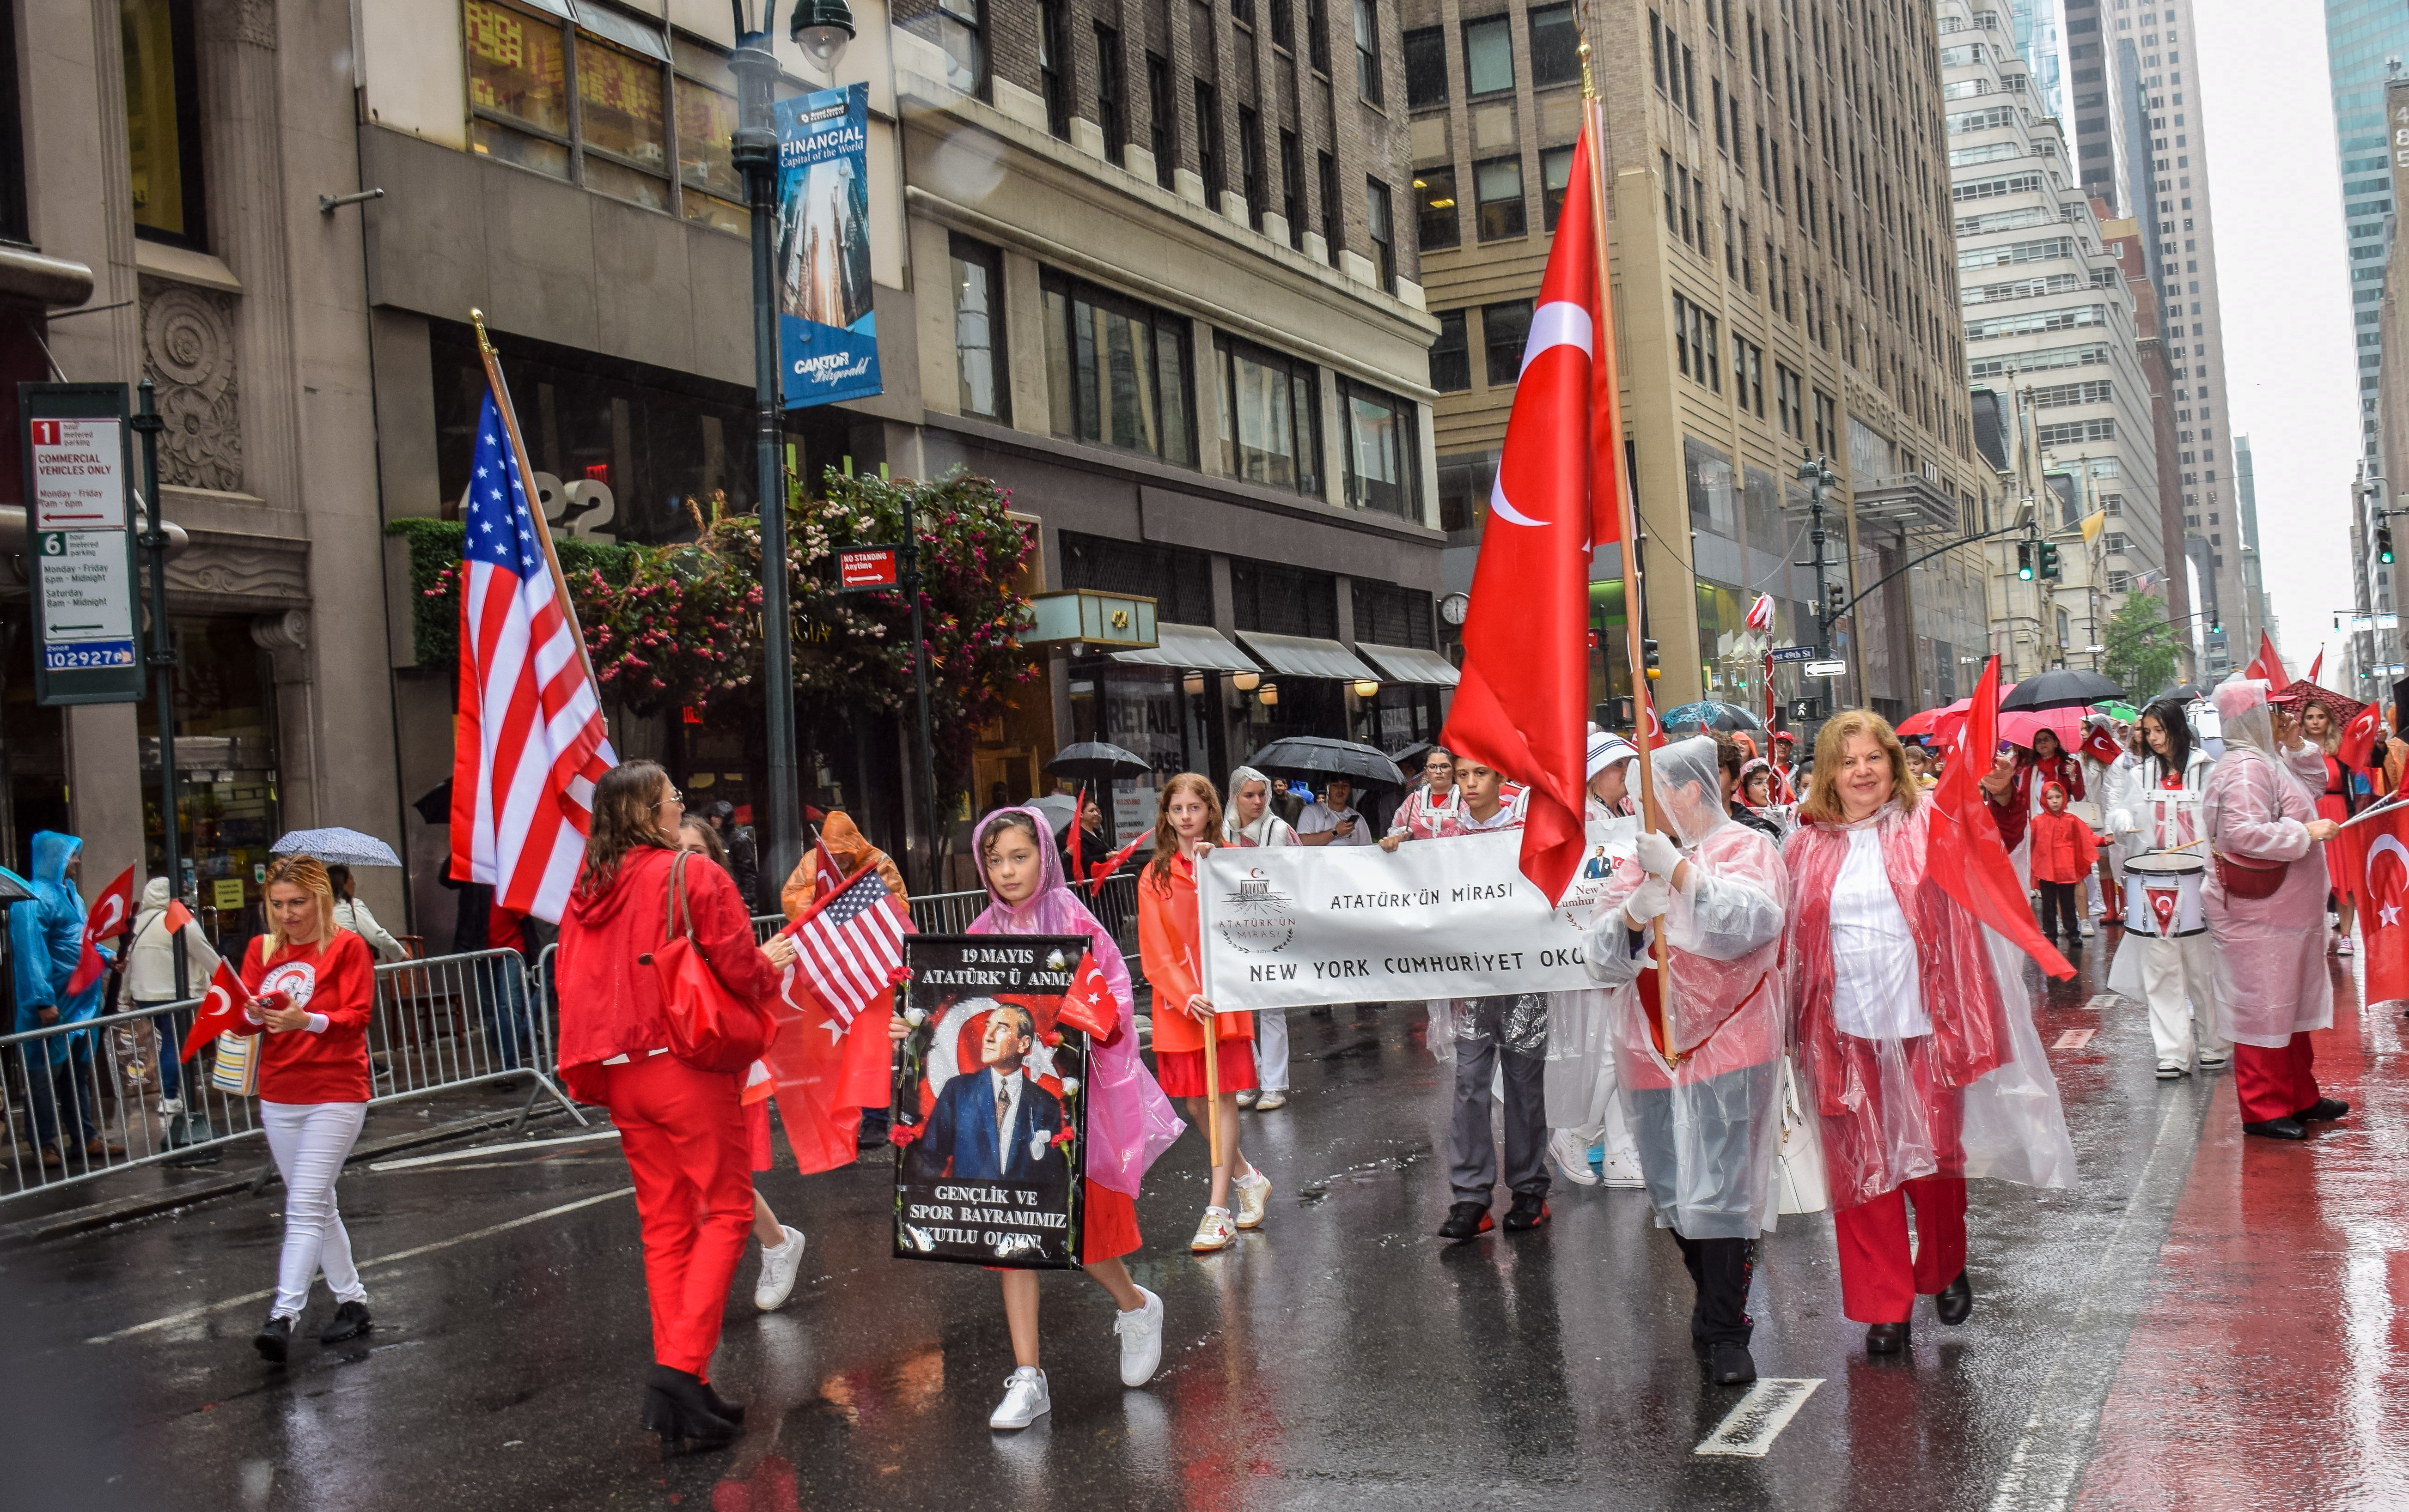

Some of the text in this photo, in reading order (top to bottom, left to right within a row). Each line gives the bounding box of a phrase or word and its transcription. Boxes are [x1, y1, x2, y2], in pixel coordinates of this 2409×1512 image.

[781, 126, 863, 157] FINANCIAL
[781, 140, 863, 168] Capital of the World
[794, 352, 849, 374] CANTOR
[41, 422, 51, 444] 1
[38, 454, 101, 464] COMMERCIAL
[39, 465, 112, 475] VEHICLES ONLY
[40, 489, 71, 499] Monday
[79, 488, 103, 499] Friday
[40, 499, 57, 508] 7am
[65, 499, 83, 509] 6pm
[46, 533, 61, 554] 6
[854, 552, 887, 562] STANDING
[44, 565, 76, 574] Monday
[83, 563, 109, 573] Friday
[845, 562, 873, 571] Anytime
[46, 575, 64, 584] 6pm
[72, 574, 106, 583] Midnight
[46, 589, 83, 599] Saturday
[47, 600, 65, 608] 8am
[73, 597, 108, 608] Midnight
[47, 650, 112, 667] 102927
[1784, 651, 1801, 659] 49th
[1802, 650, 1811, 658] St
[1108, 698, 1178, 734] RETAIL
[1330, 882, 1512, 910] ATATÜRK'ÜN MİRASI
[1575, 885, 1599, 896] New
[1219, 917, 1296, 929] ATATÜRK'ÜN
[961, 948, 1034, 964] 19 MAYIS
[1250, 963, 1298, 983] NEW
[1313, 958, 1371, 980] YORK
[1384, 951, 1524, 975] CUMHURİYET
[1009, 967, 1022, 985] Ü
[934, 1185, 1037, 1206] GENÇLİK VE
[909, 1204, 1067, 1228] SPOR BAYRAMIMIZ
